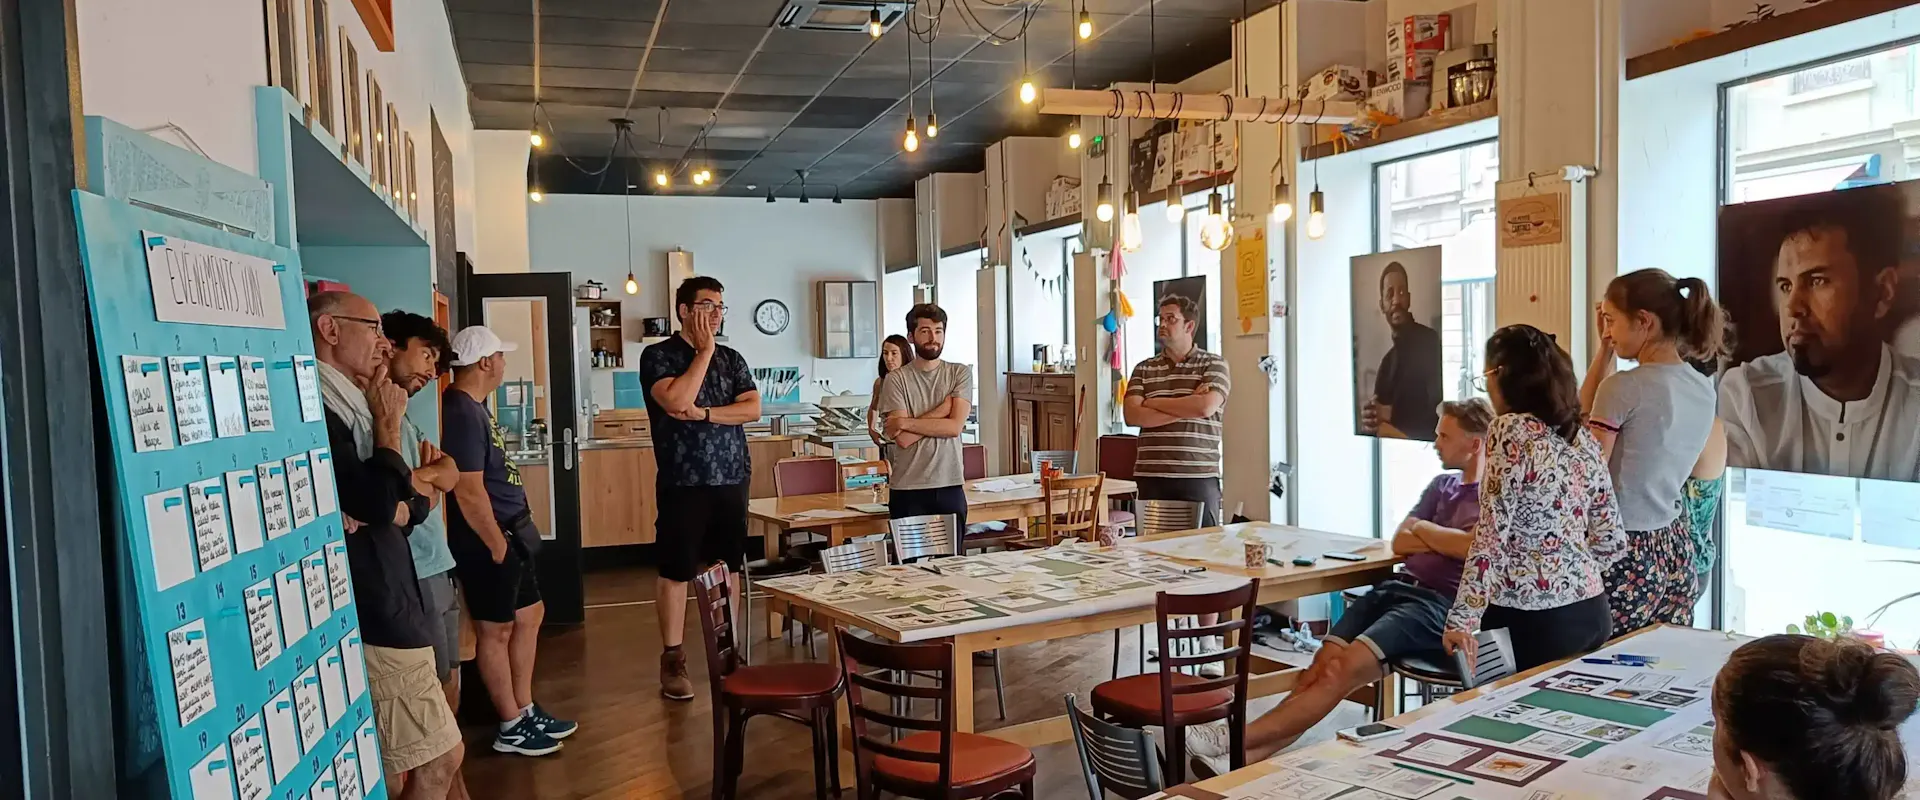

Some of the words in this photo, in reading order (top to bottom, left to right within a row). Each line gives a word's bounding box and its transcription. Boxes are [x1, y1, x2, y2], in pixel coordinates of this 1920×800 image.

[241, 265, 265, 318] JUIN
[132, 331, 139, 350] 1
[174, 334, 182, 351] 2
[212, 337, 219, 352] 3
[244, 338, 250, 352] 4
[153, 470, 160, 488] 7
[303, 536, 310, 551] 17
[278, 550, 286, 565] 16
[249, 564, 257, 581] 15
[216, 582, 225, 600] 14
[176, 602, 186, 621] 13
[340, 614, 348, 630] 24
[319, 633, 326, 648] 23
[295, 655, 303, 672] 22
[268, 678, 276, 694] 21
[235, 703, 246, 722] 20
[198, 731, 207, 751] 19
